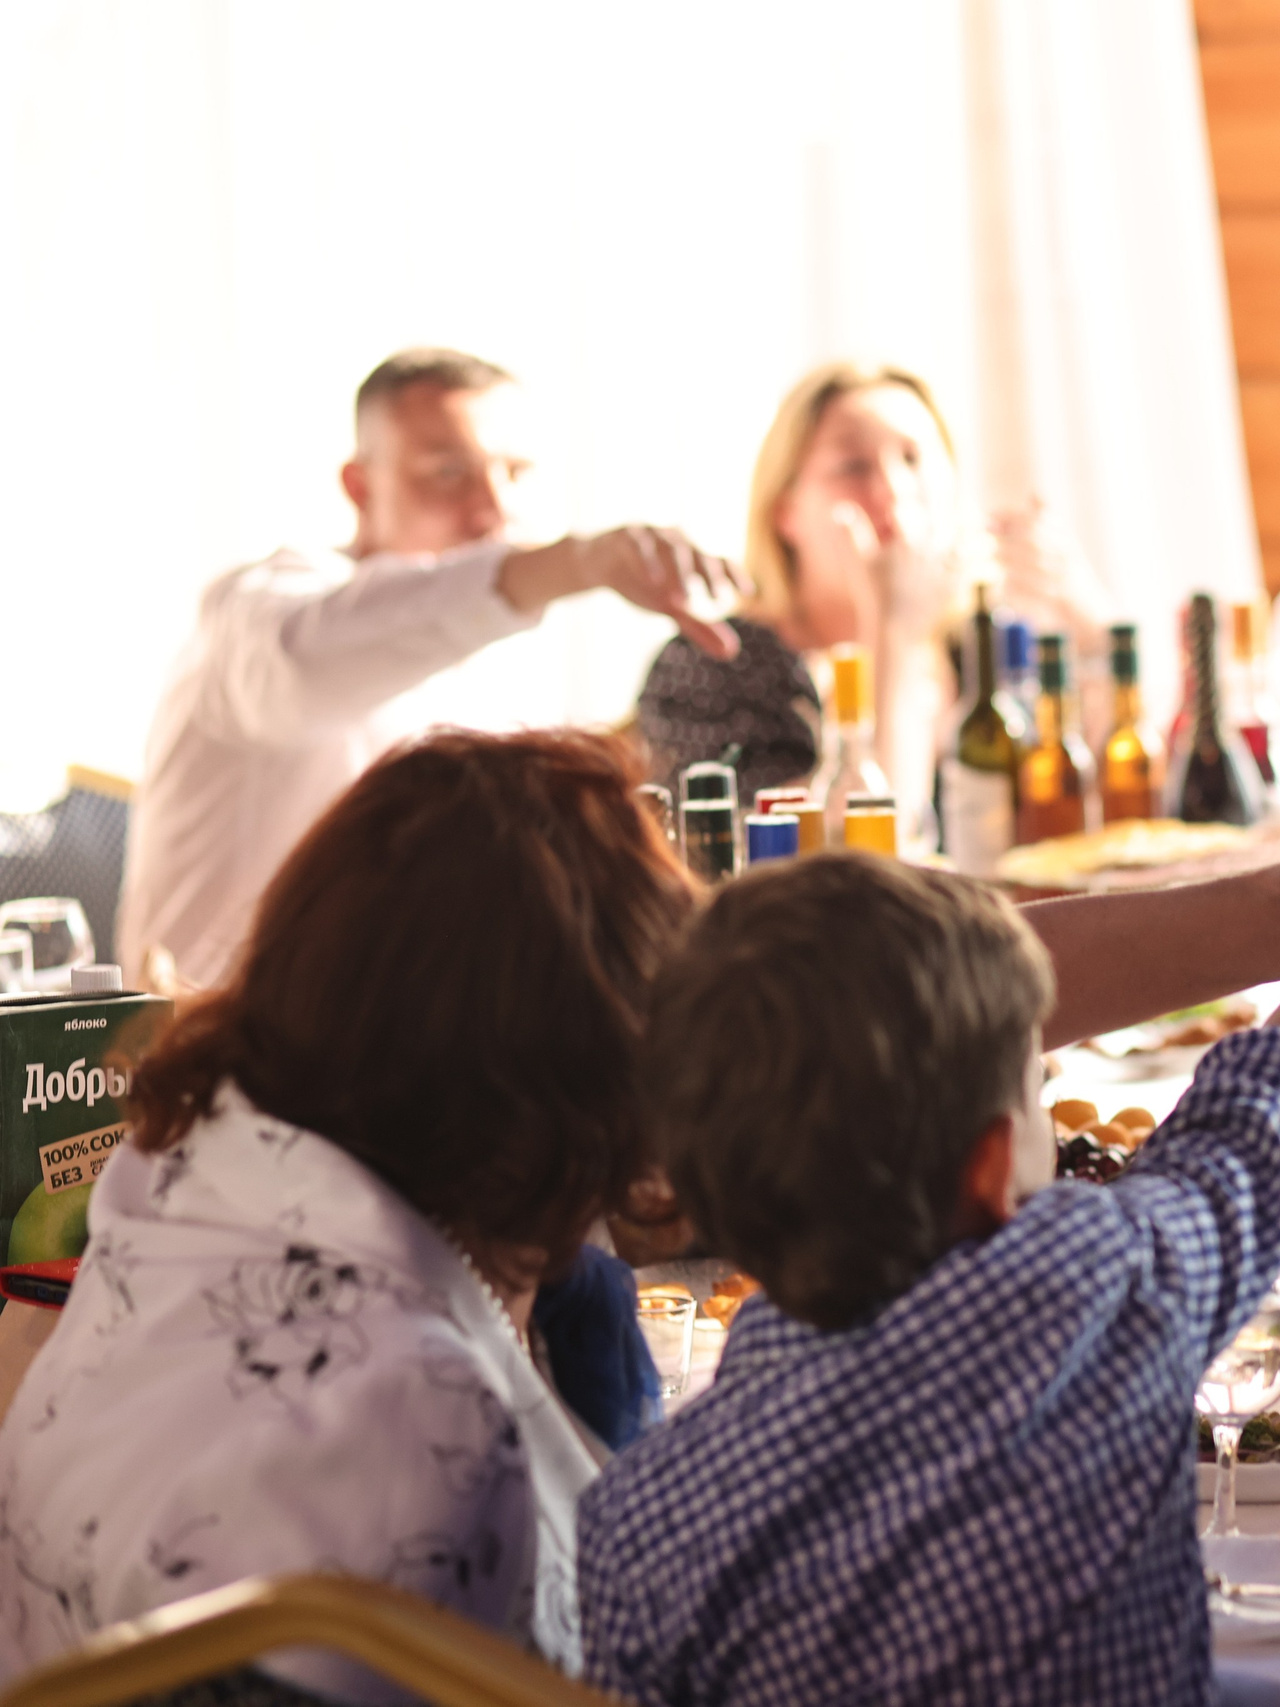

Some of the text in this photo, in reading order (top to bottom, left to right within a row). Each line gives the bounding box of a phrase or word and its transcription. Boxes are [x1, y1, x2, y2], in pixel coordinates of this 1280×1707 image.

[64, 1018, 107, 1032] яблоко
[22, 1057, 133, 1114] Добры
[43, 1139, 89, 1167] 100%
[89, 1128, 125, 1152] СОК
[50, 1166, 83, 1189] БЕЗ
